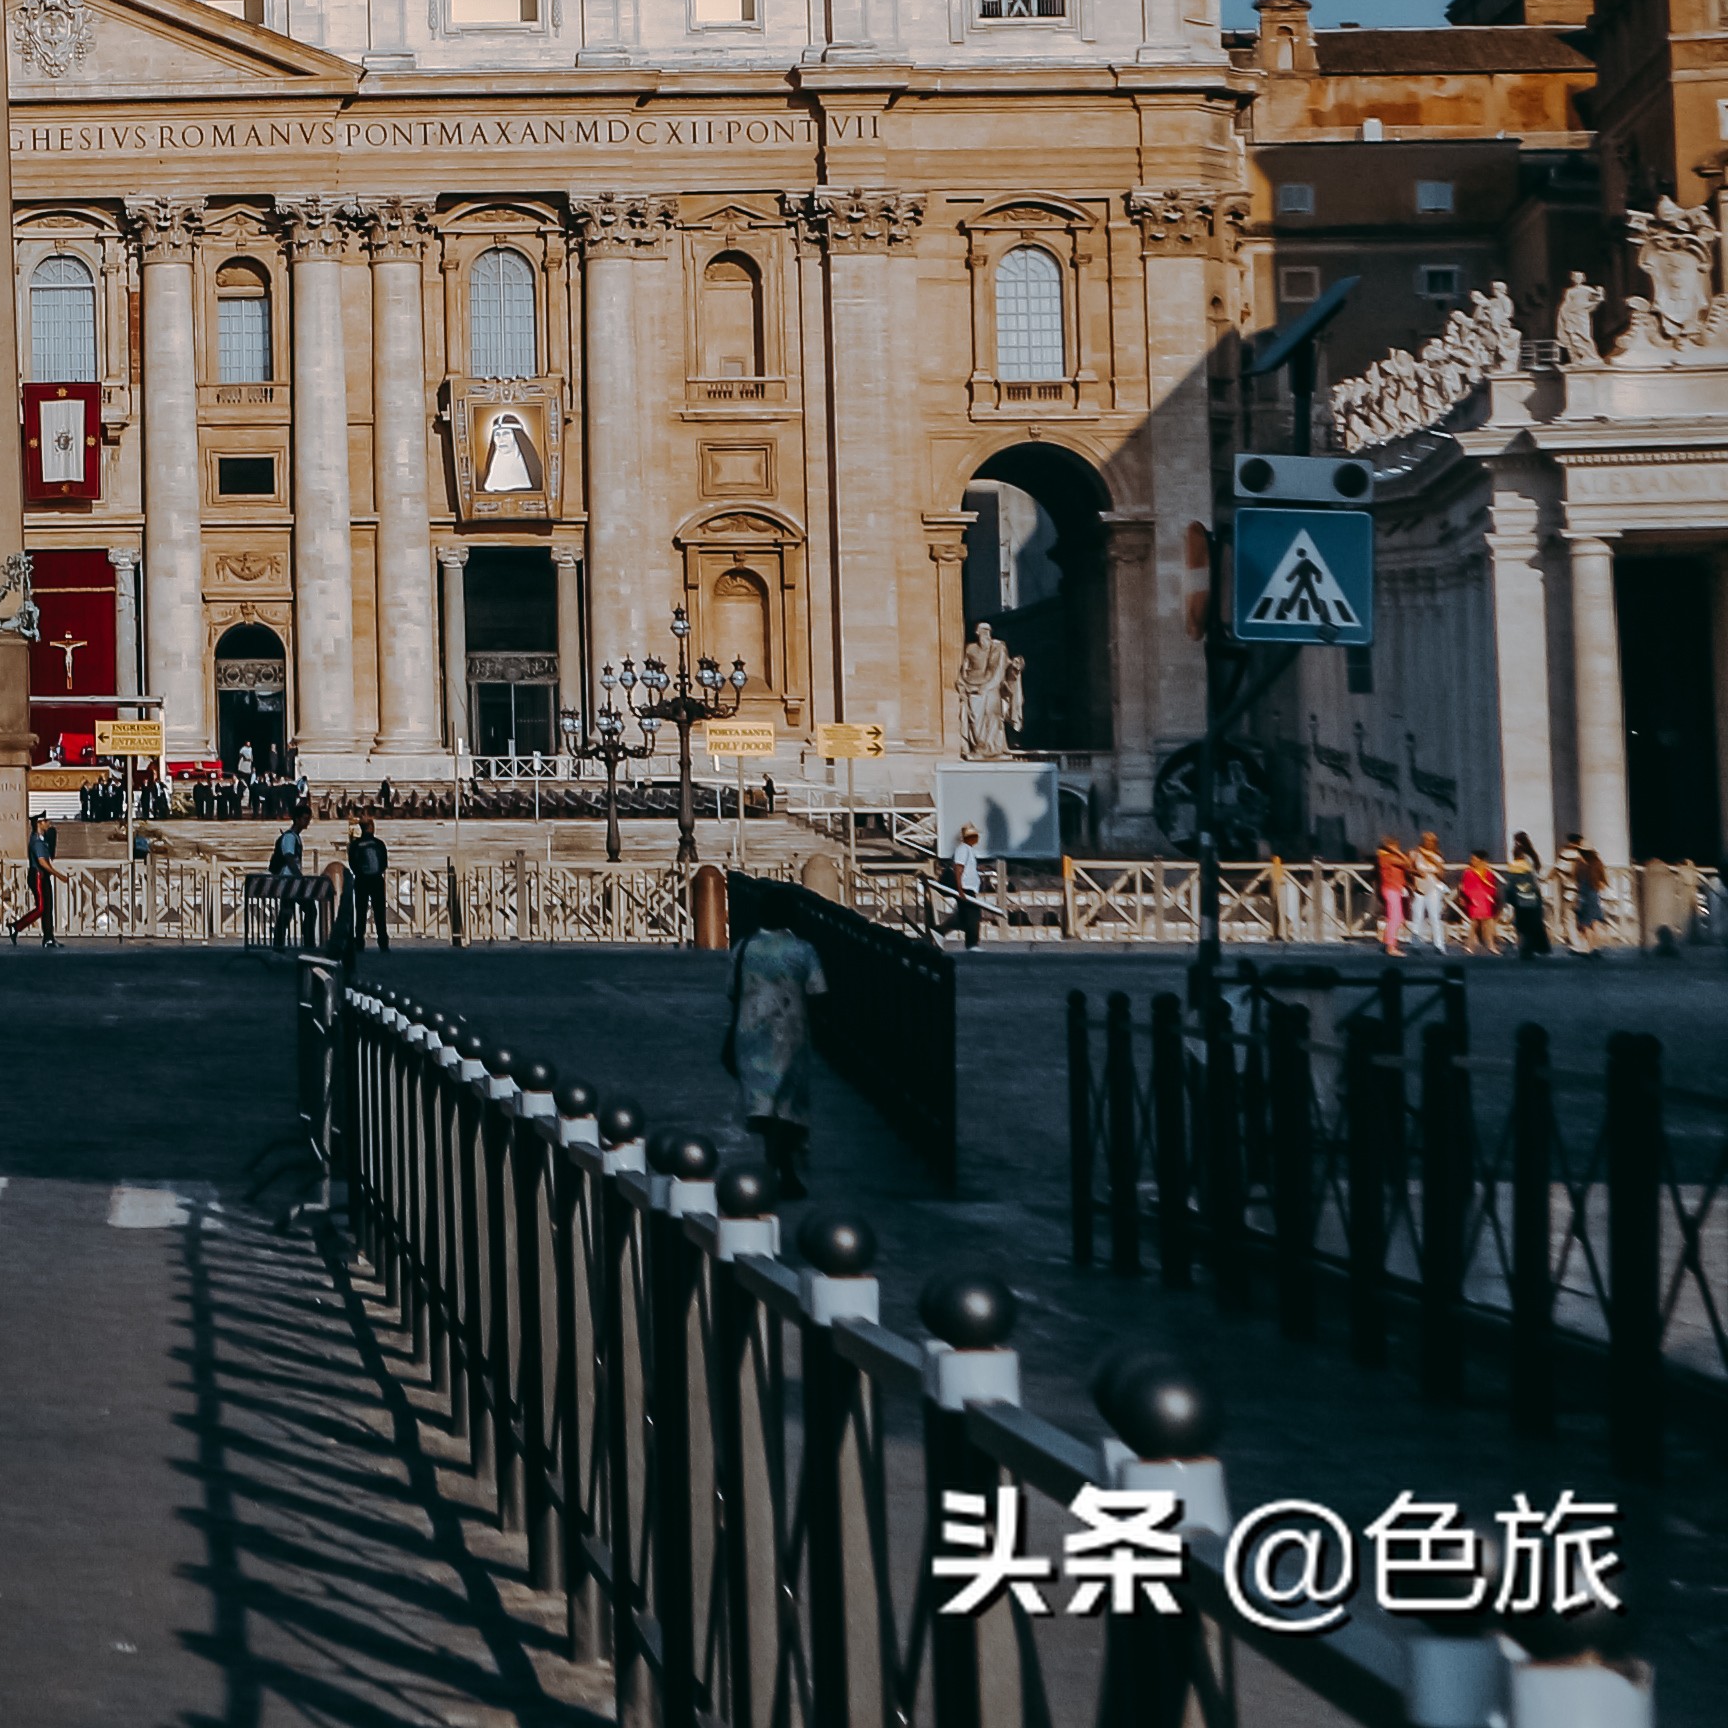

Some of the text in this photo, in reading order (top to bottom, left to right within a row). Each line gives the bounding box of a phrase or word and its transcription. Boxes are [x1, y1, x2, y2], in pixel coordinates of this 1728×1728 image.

[9, 125, 146, 152] GHESIVS
[157, 122, 335, 149] ROMANVS
[345, 122, 435, 147] PONT
[439, 121, 514, 145] MAX
[574, 119, 714, 145] MDCXII
[726, 119, 815, 144] PONT
[830, 114, 880, 139] VII
